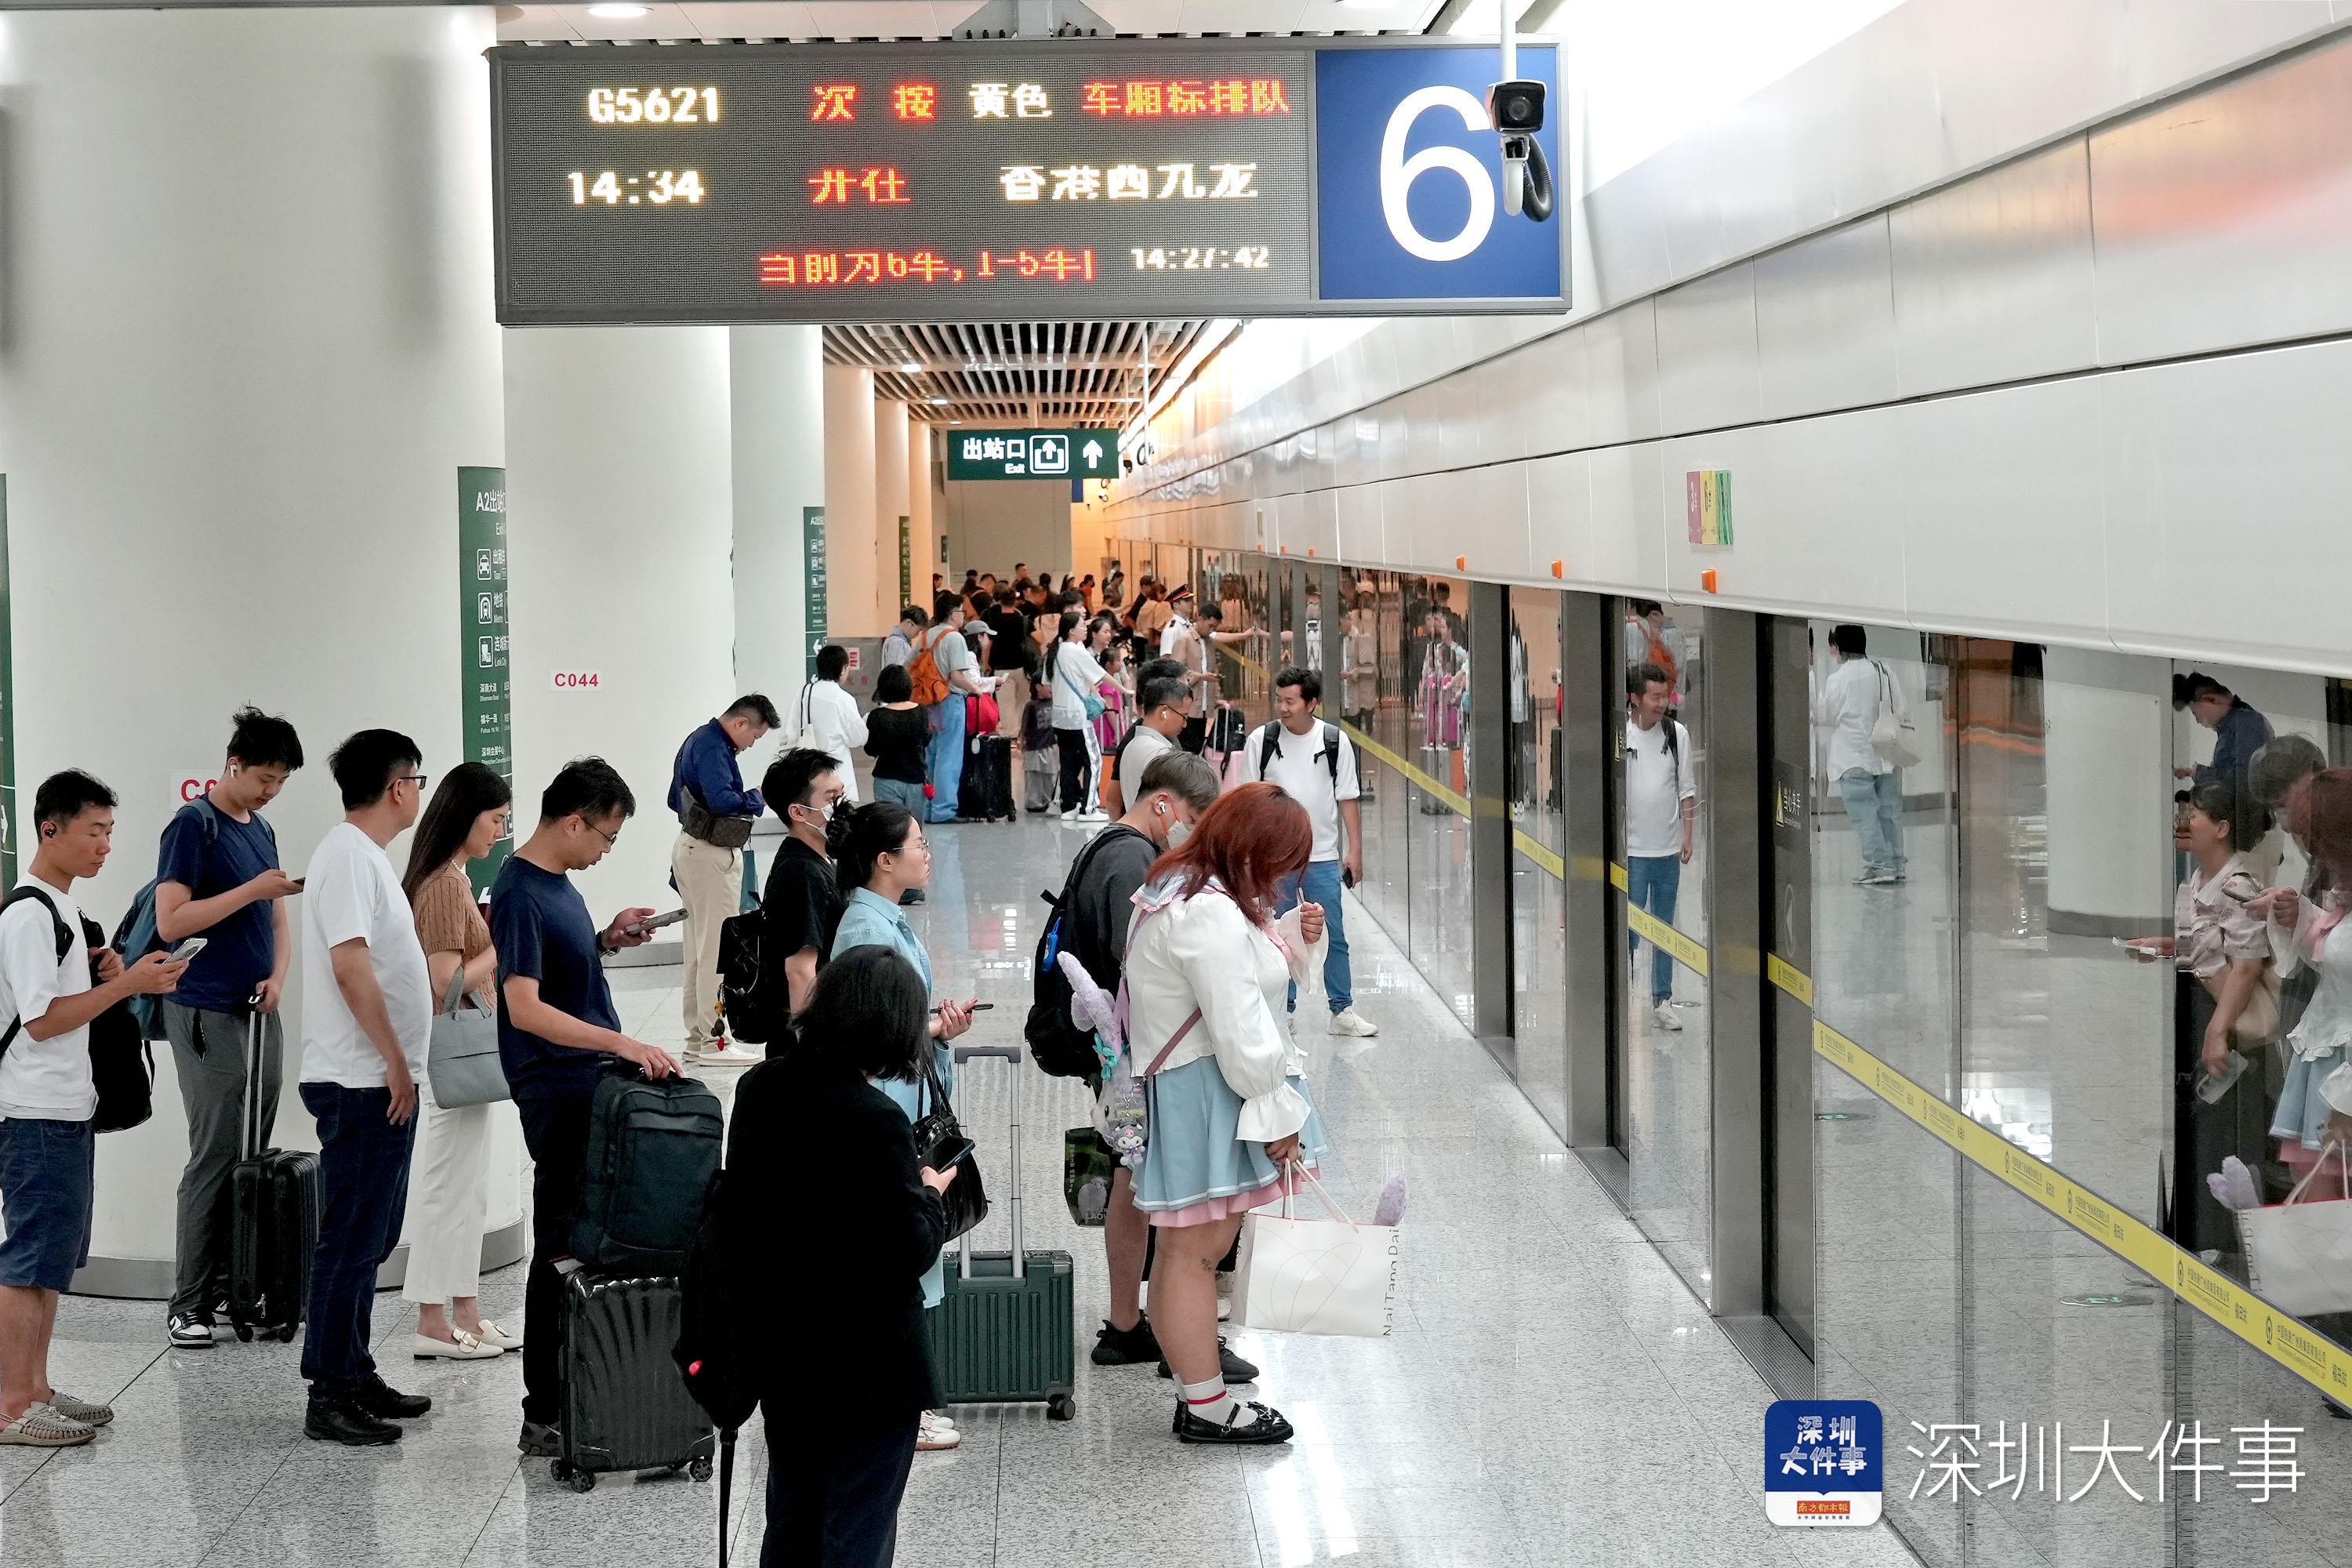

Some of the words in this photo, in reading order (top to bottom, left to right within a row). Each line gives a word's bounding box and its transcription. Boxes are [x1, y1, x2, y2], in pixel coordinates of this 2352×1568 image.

[588, 87, 719, 123] G5621
[811, 83, 858, 121] 次
[895, 83, 935, 121] 按
[967, 82, 1053, 119] 黄色
[567, 170, 706, 205] 14:34
[1379, 85, 1496, 263] 6
[963, 437, 1025, 460] 出站口
[1005, 463, 1025, 474] Exit
[554, 673, 600, 688] C044
